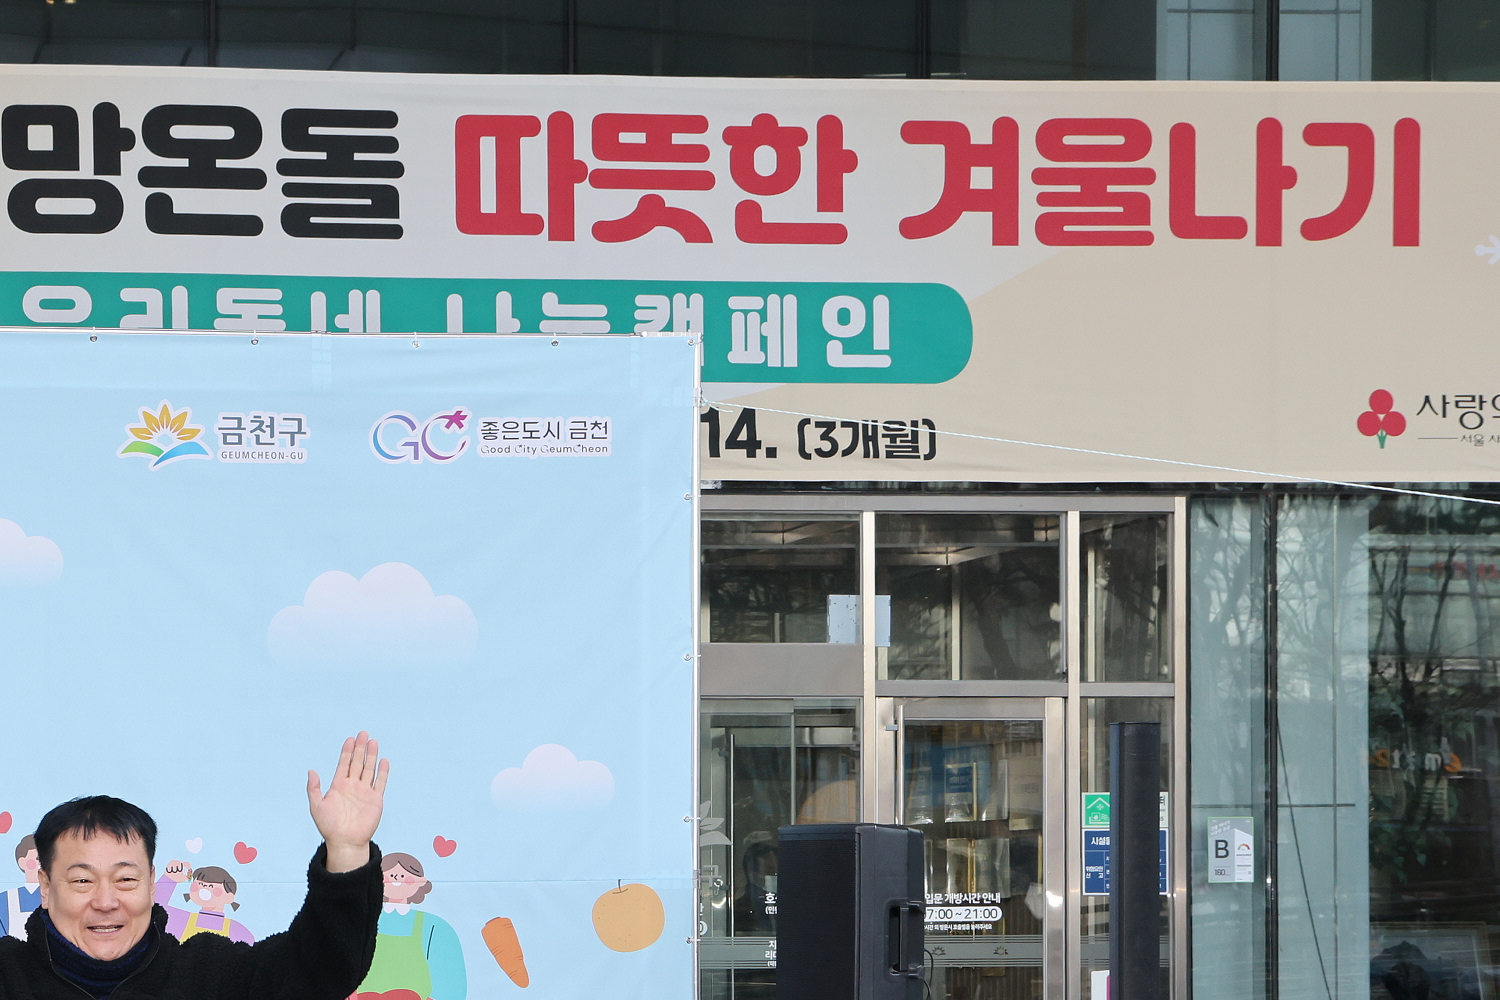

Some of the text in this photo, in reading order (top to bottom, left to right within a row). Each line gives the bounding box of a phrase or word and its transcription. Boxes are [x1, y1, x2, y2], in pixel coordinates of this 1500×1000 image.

[453, 110, 858, 246] 따뜻한
[898, 115, 1421, 247] 겨울나기
[1416, 393, 1500, 430] 사랑
[217, 415, 307, 447] 금천구
[480, 420, 608, 441] 좋은도시 금천
[797, 417, 937, 461] (3개월)
[1460, 433, 1484, 447] 서울
[221, 450, 304, 460] GEUMCHEON-GU
[480, 444, 511, 454] Good
[514, 444, 537, 456] City
[1214, 839, 1230, 859] B
[944, 892, 981, 904] 개방시간
[982, 892, 1001, 904] 안내
[924, 908, 953, 920] 7:00
[964, 908, 998, 919] 21:00
